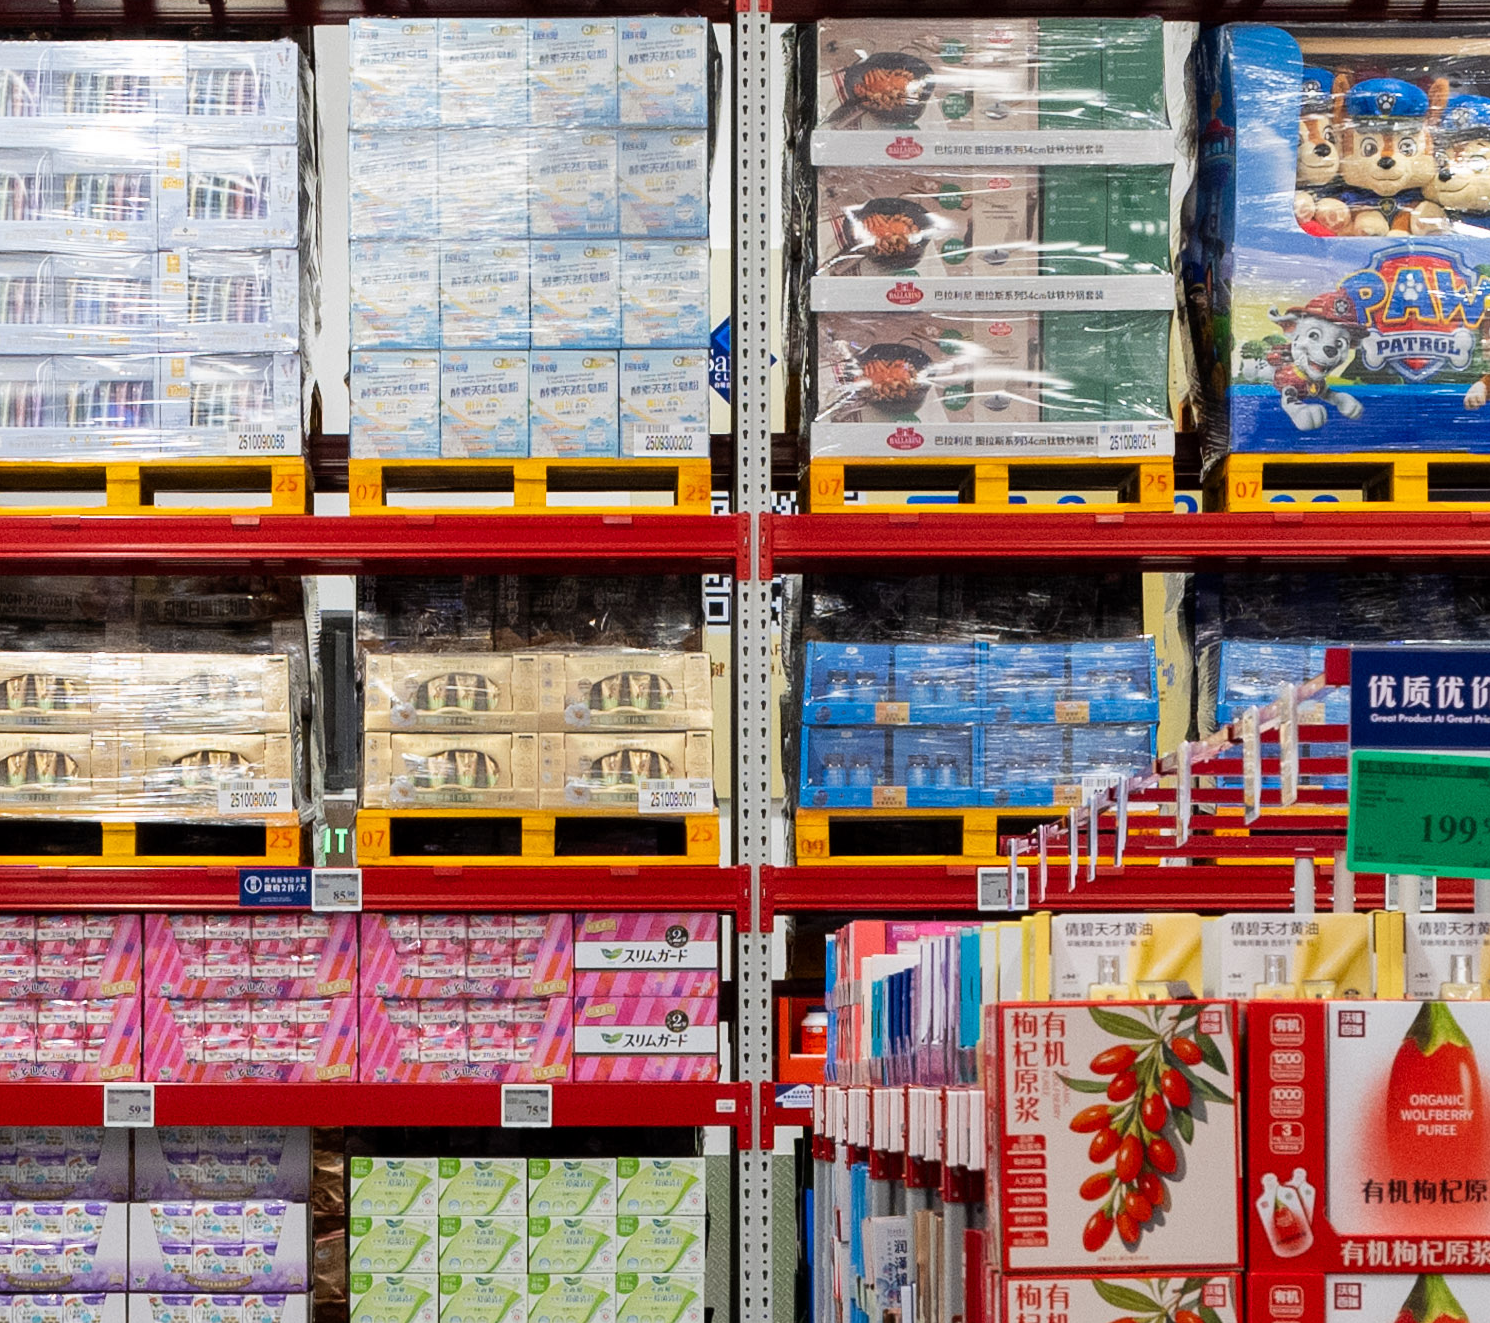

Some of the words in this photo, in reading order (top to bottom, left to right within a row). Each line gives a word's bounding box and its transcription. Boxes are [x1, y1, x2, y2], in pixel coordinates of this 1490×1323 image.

[1376, 334, 1462, 354] PATROL
[238, 434, 285, 450] 2510090058
[645, 435, 693, 451] 2509300202
[1145, 473, 1168, 492] 25
[1370, 714, 1397, 723] Great
[1399, 714, 1432, 723] Product
[1434, 714, 1444, 722] At
[1447, 714, 1473, 723] Great
[230, 792, 278, 807] 2510080002
[649, 793, 697, 808] 2510080001
[1065, 921, 1154, 937] 倩碧天才黄油
[623, 948, 688, 963] スリムガード
[1043, 1012, 1067, 1067] 有机
[1012, 1014, 1039, 1123] 枸杞原浆
[1410, 1095, 1464, 1107] ORGANIC
[1400, 1110, 1474, 1122] WOLFBERRY
[1418, 1124, 1457, 1136] PUREE
